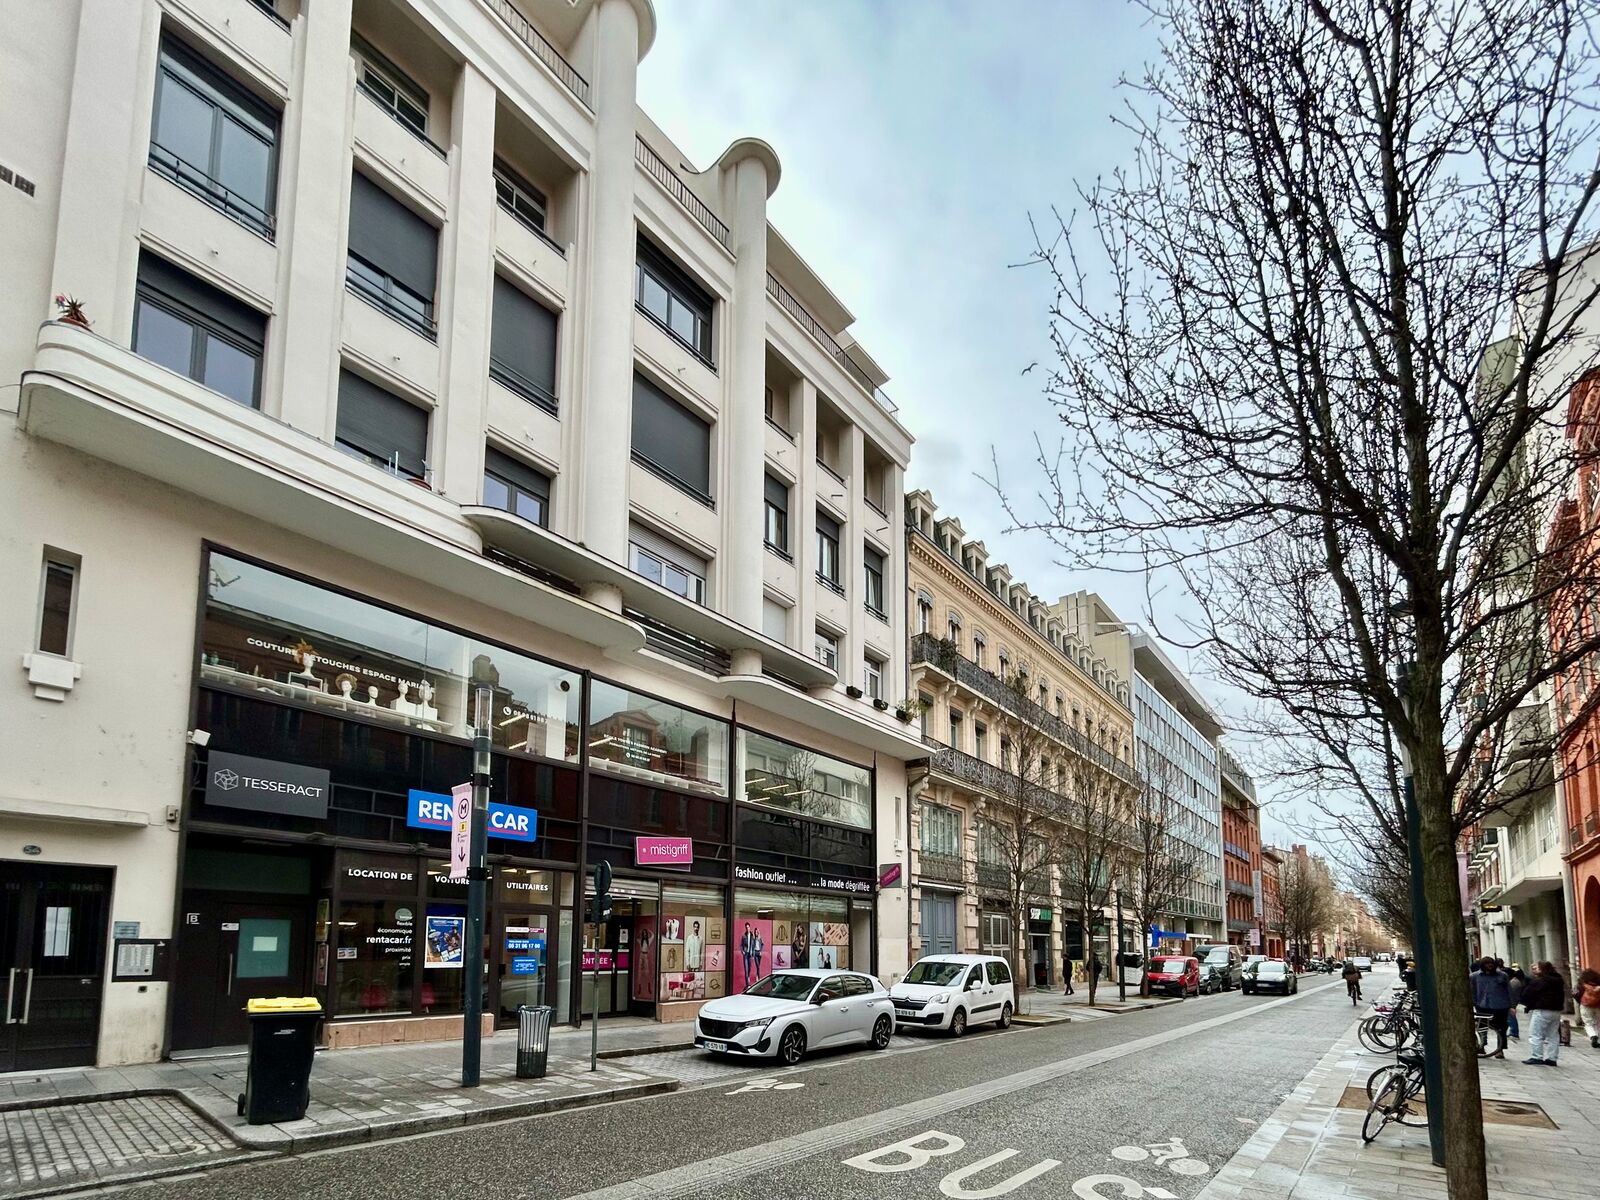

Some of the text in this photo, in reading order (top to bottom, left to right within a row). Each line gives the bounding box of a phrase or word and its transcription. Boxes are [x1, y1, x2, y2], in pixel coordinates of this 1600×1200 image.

[363, 668, 397, 683] ESPACE
[242, 776, 323, 798] TESSERACT
[418, 800, 529, 832] REN CAR
[650, 843, 688, 858] mistigriff
[348, 868, 398, 879] LOCATION
[400, 872, 413, 881] DE
[506, 882, 549, 891] UTILITAIRES
[735, 866, 764, 880] fashion
[765, 871, 786, 883] outlet
[827, 880, 845, 889] mode
[377, 927, 413, 935] économique
[366, 936, 412, 944] rentacar.fr
